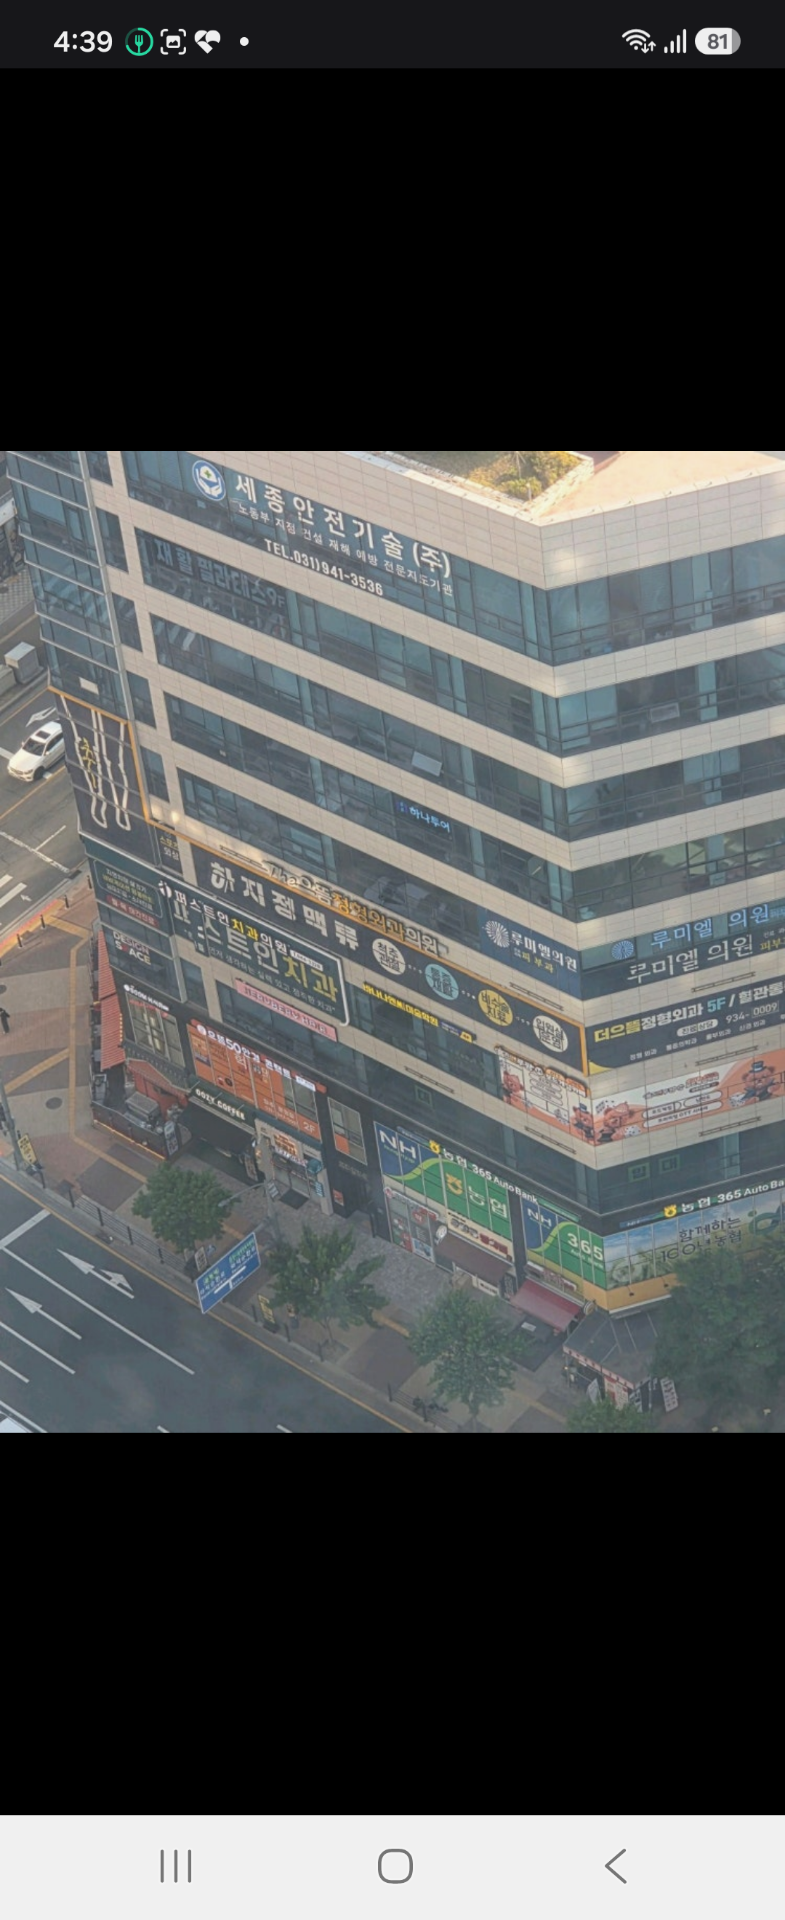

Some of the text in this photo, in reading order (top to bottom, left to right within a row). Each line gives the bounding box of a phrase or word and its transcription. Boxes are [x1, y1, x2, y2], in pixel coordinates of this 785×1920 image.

[239, 504, 453, 597] 노동부 지정 건설 재해 예방 전문지도기관
[409, 806, 450, 833] 하나투어
[210, 861, 359, 951] 하지정맥류
[651, 918, 713, 949] 루미엘
[728, 904, 770, 928] 의원
[113, 930, 149, 955] DESIGN
[627, 934, 754, 984] 루미엘 의원
[594, 1003, 704, 1043] 더으뜸정형외과
[707, 997, 726, 1013] 5F
[217, 1100, 246, 1120] COFFEE
[303, 1121, 316, 1134] 2F
[379, 1130, 417, 1159] NH
[443, 1148, 467, 1169] 농협
[472, 1164, 492, 1182] 365
[469, 1186, 508, 1219] 농협
[681, 1196, 711, 1213] 농협
[717, 1189, 741, 1204] 365
[527, 1208, 552, 1227] NH
[679, 1217, 741, 1242] 함께하는
[567, 1232, 604, 1261] 365
[715, 1230, 742, 1246] 농협
